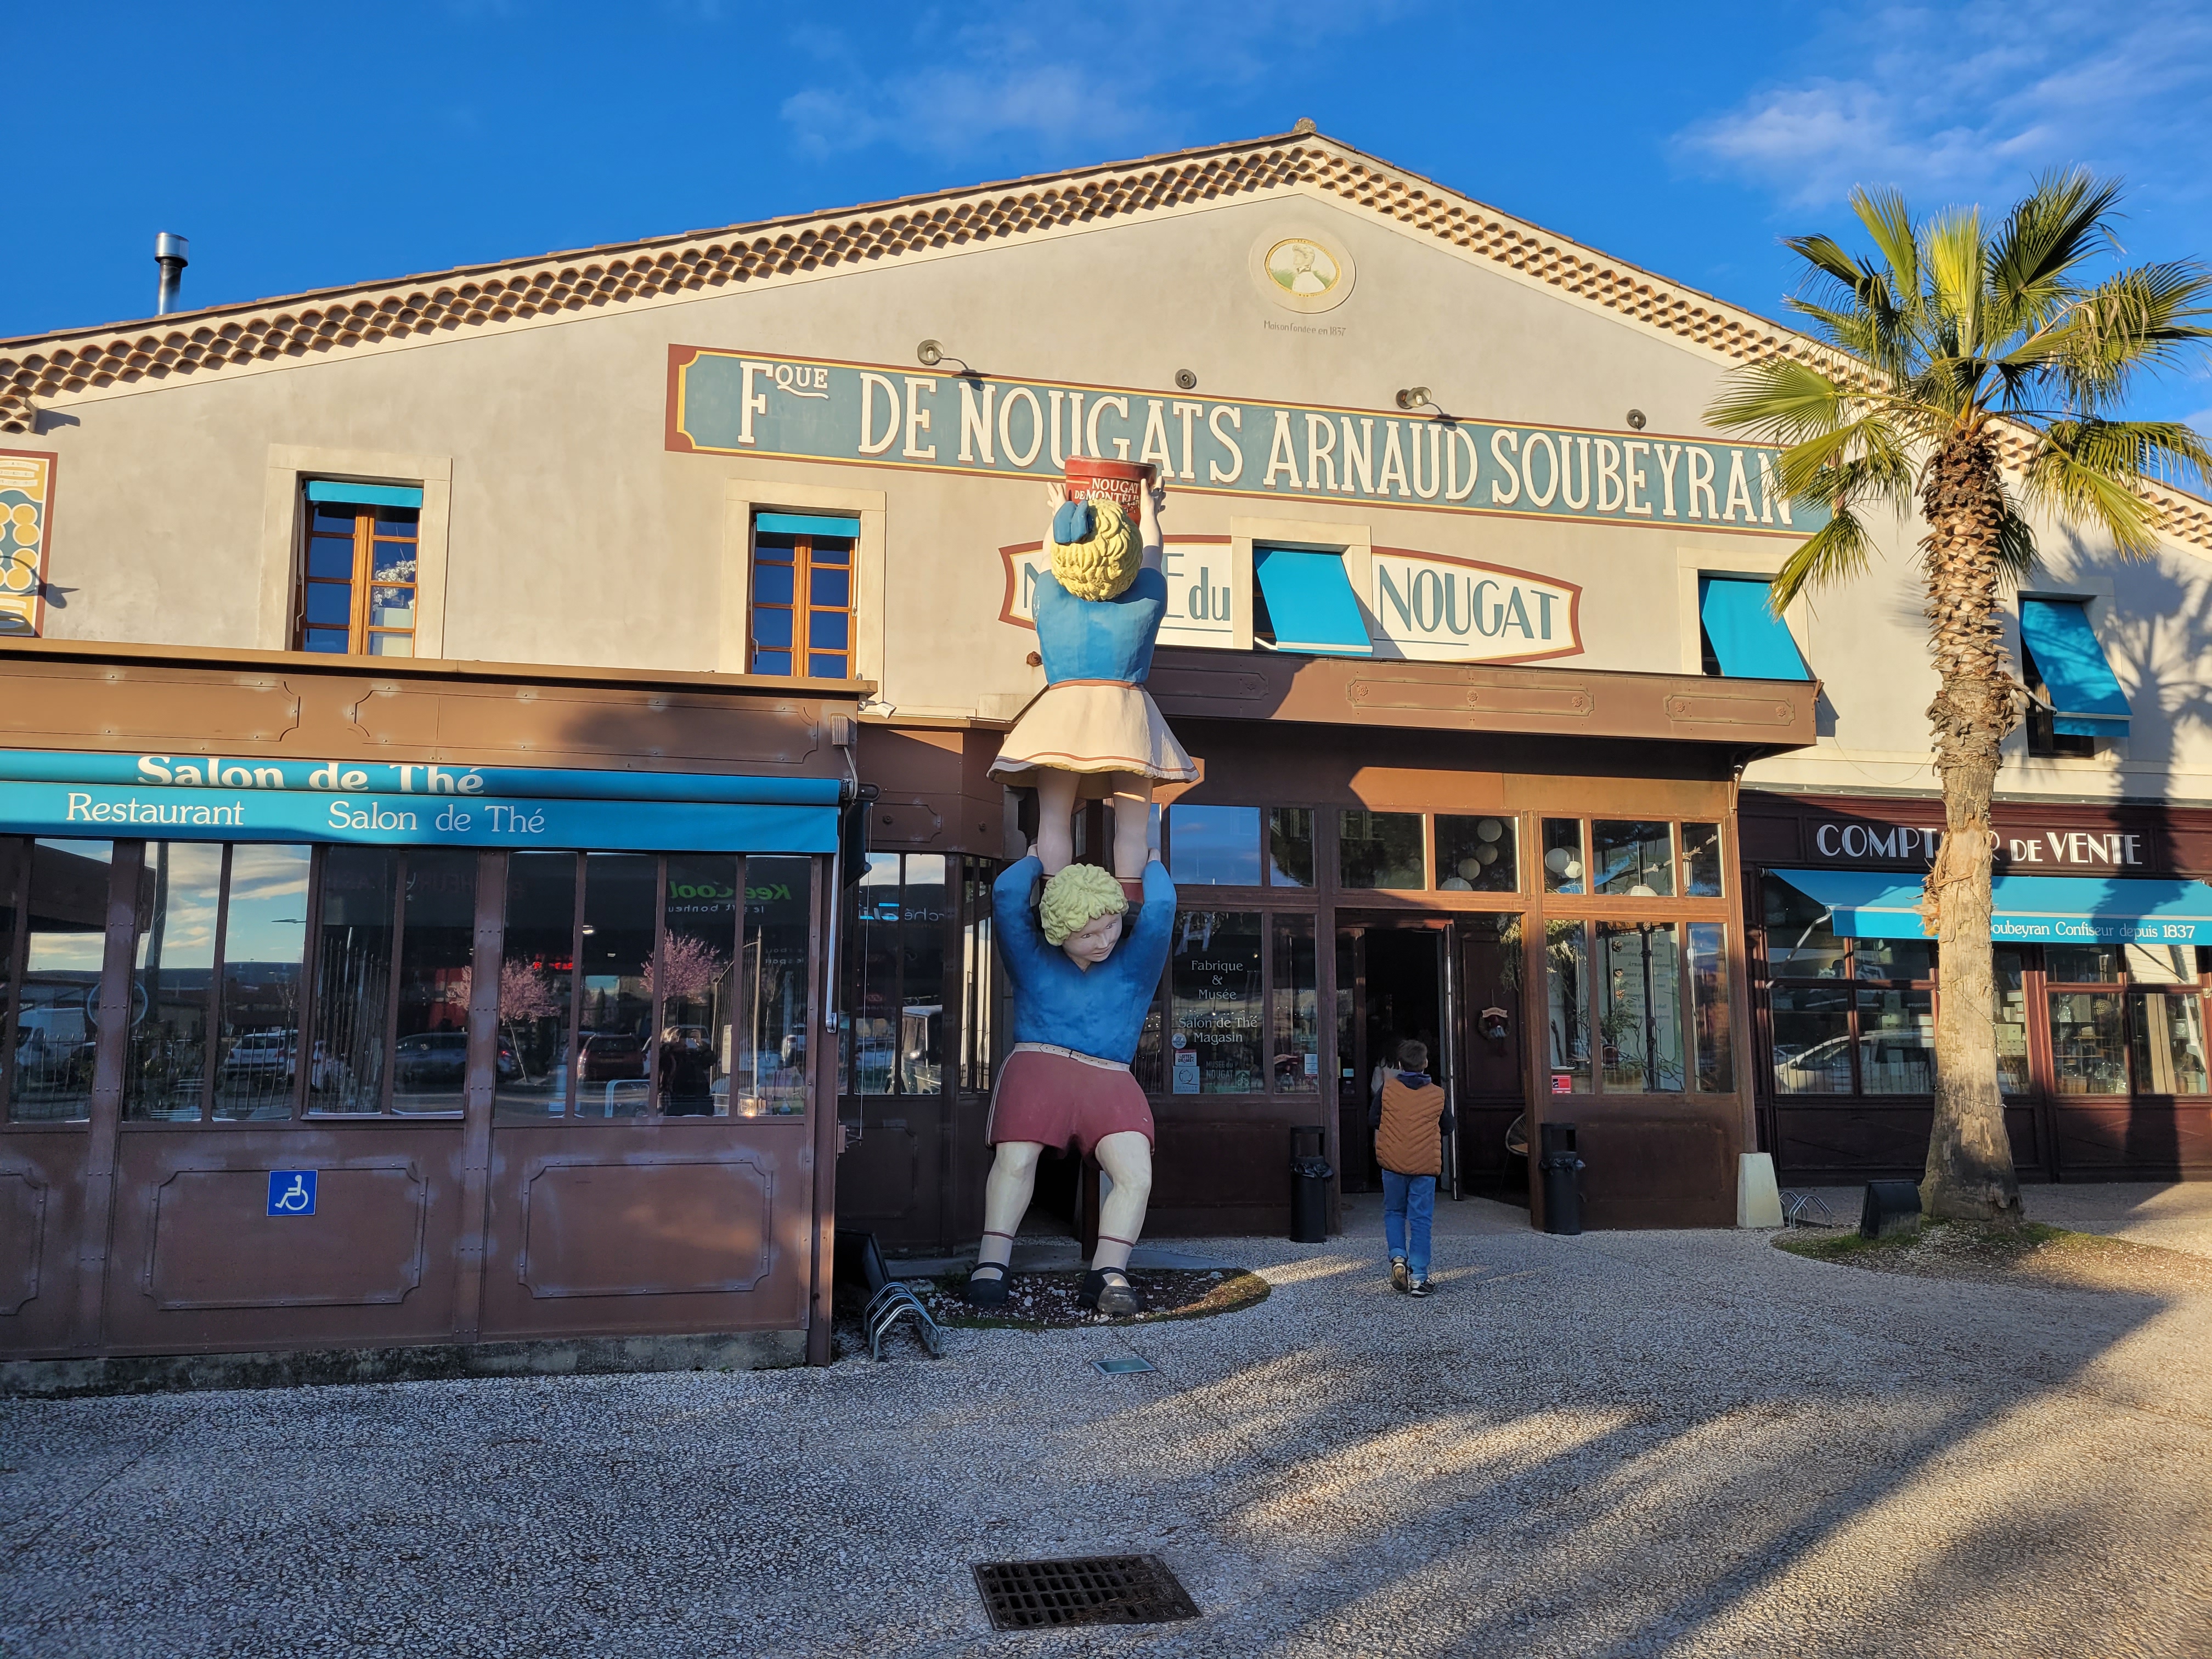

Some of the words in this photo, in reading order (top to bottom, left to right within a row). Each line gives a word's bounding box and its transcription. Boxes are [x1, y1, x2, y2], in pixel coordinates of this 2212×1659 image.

[1263, 320, 1289, 331] Maison
[1290, 322, 1317, 334] fondée
[1329, 326, 1347, 337] 1837
[857, 372, 937, 461] DE
[957, 381, 1243, 486] NOUGATS
[1263, 410, 1479, 501] ARNAUD
[1491, 428, 1793, 525] SOUBEYRAN
[1092, 478, 1140, 494] NOUGAT
[1074, 490, 1085, 500] DE
[1188, 567, 1231, 621] du
[1379, 563, 1559, 641] NOUGAT
[137, 755, 286, 789] Salon
[308, 762, 370, 791] de
[389, 765, 485, 795] Thé
[66, 792, 245, 826] Restaurant
[328, 800, 418, 831] Salon
[436, 803, 472, 832] de
[484, 804, 545, 834] Thé
[1816, 824, 2000, 861] COMPTR
[2010, 839, 2043, 862] DE
[2046, 832, 2143, 865] VENTE
[1991, 919, 2050, 939] oubeyran
[2055, 921, 2113, 937] Confiseur
[2119, 922, 2158, 941] depuis
[2162, 923, 2196, 940] 1837
[1191, 960, 1244, 974] Fabrique
[1212, 975, 1223, 985] &
[1198, 988, 1237, 1000] Musée
[1178, 1017, 1212, 1029] Salon
[1216, 1017, 1231, 1028] de
[1234, 1016, 1258, 1028] Thé
[1193, 1032, 1243, 1046] Magasin
[1206, 1069, 1233, 1079] NOUGAT
